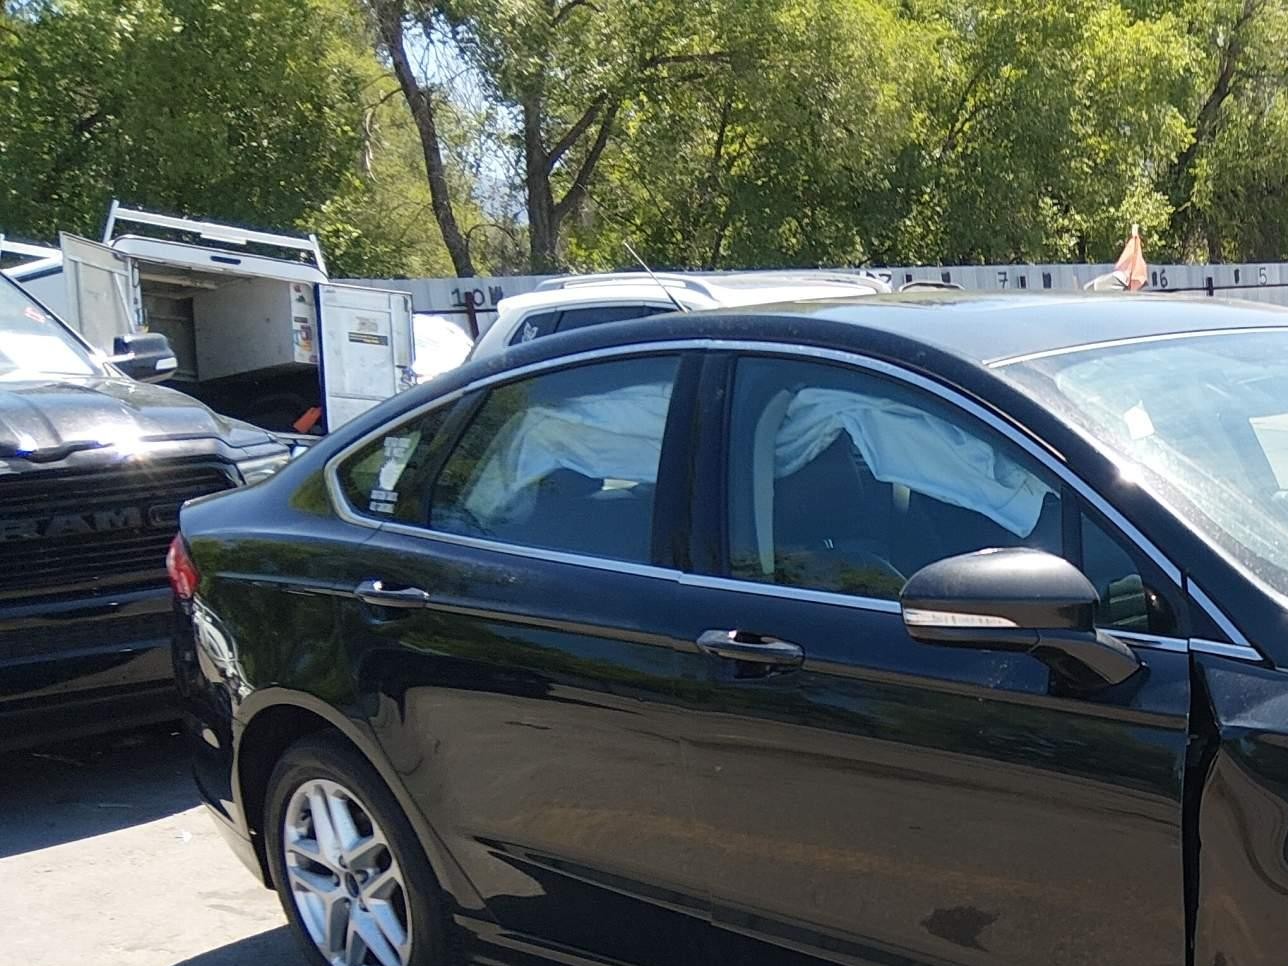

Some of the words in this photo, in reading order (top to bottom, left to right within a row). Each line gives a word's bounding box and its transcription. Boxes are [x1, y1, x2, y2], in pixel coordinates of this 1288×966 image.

[998, 271, 1008, 289] 7
[1160, 268, 1169, 288] 6
[1259, 267, 1267, 285] 5
[0, 506, 142, 541] RAM
